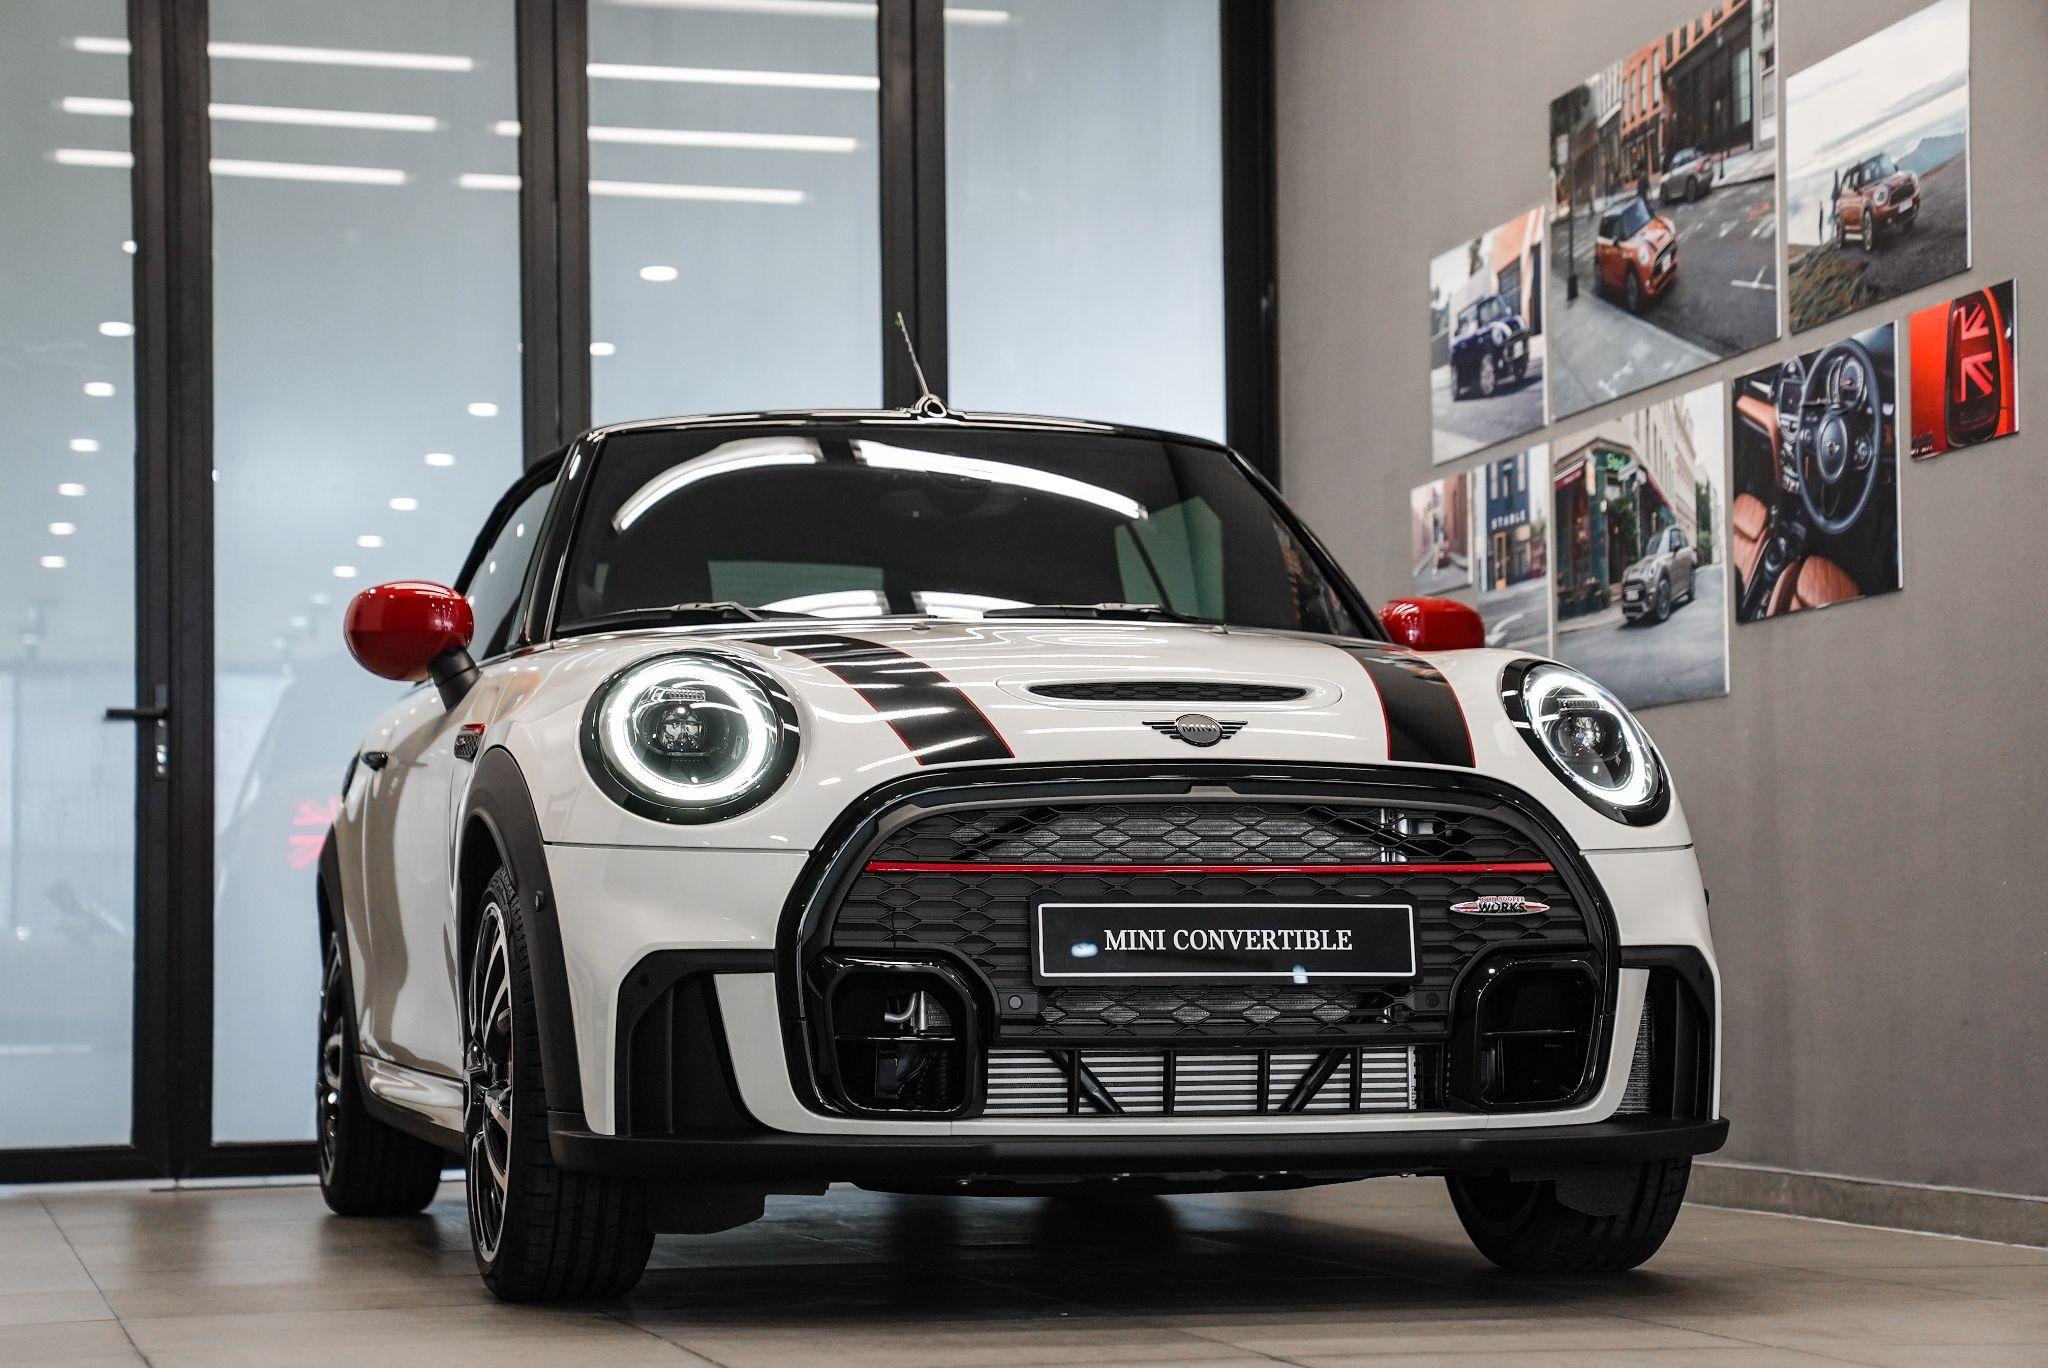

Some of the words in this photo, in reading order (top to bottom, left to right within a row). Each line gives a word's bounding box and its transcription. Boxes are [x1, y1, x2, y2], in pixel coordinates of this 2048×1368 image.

[1181, 723, 1217, 733] MINI
[1478, 902, 1527, 913] WORKS
[1104, 929, 1166, 950] MINI
[1173, 929, 1353, 950] CONVERTIBLE
